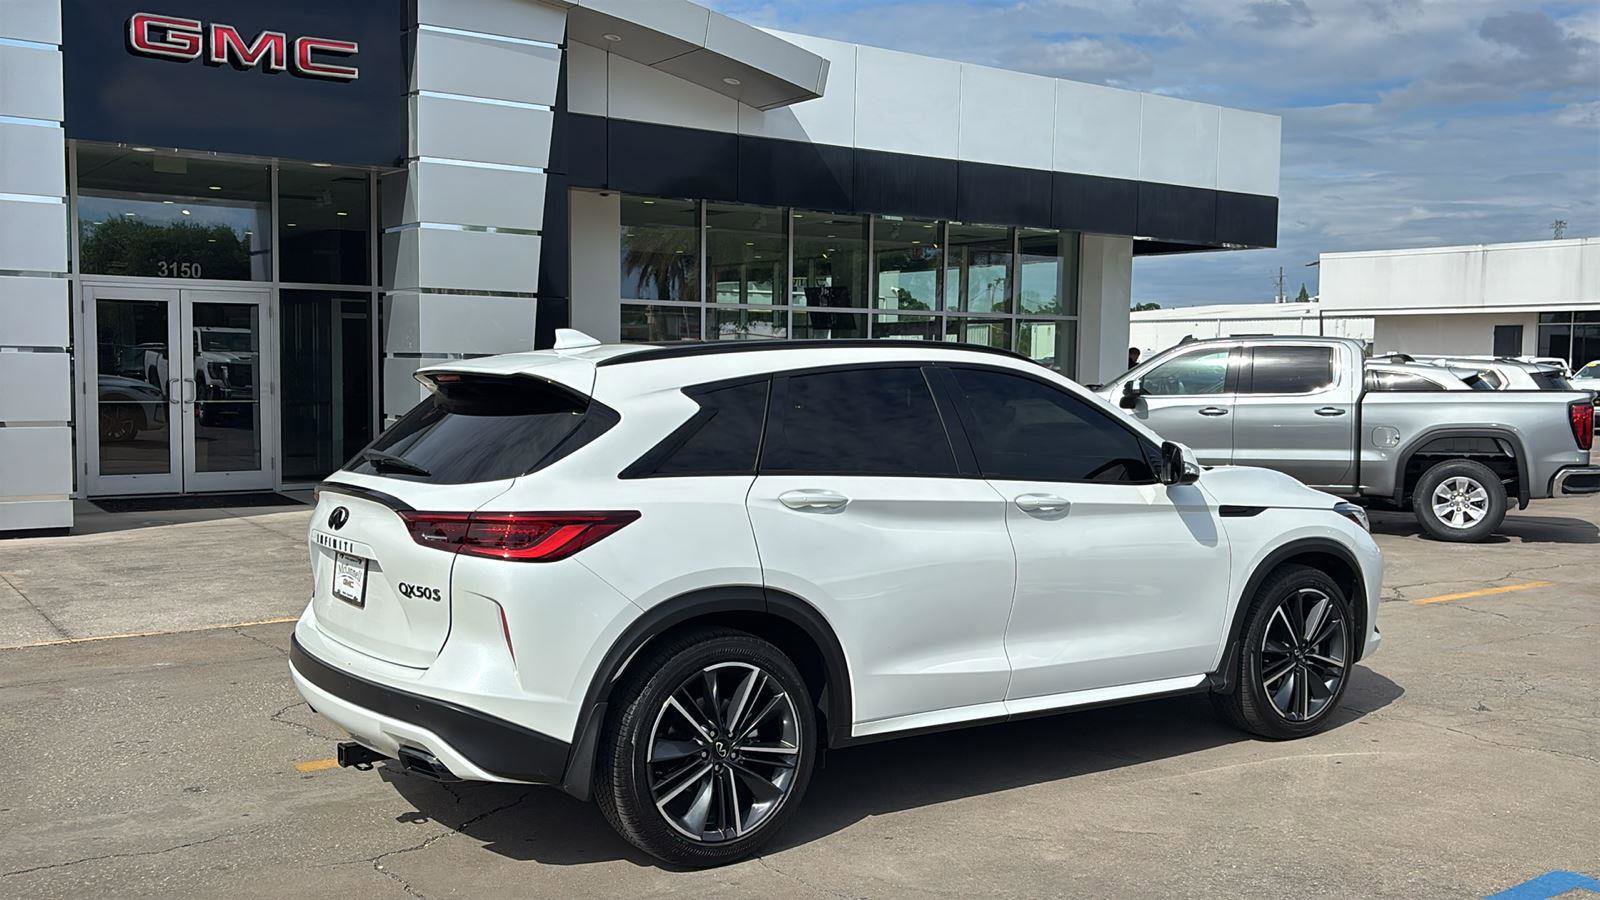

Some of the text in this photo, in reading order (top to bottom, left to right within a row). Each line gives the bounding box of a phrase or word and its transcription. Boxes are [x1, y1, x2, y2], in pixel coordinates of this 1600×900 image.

[128, 12, 359, 81] GMC
[158, 261, 202, 279] 3150
[316, 533, 353, 553] INFINITI
